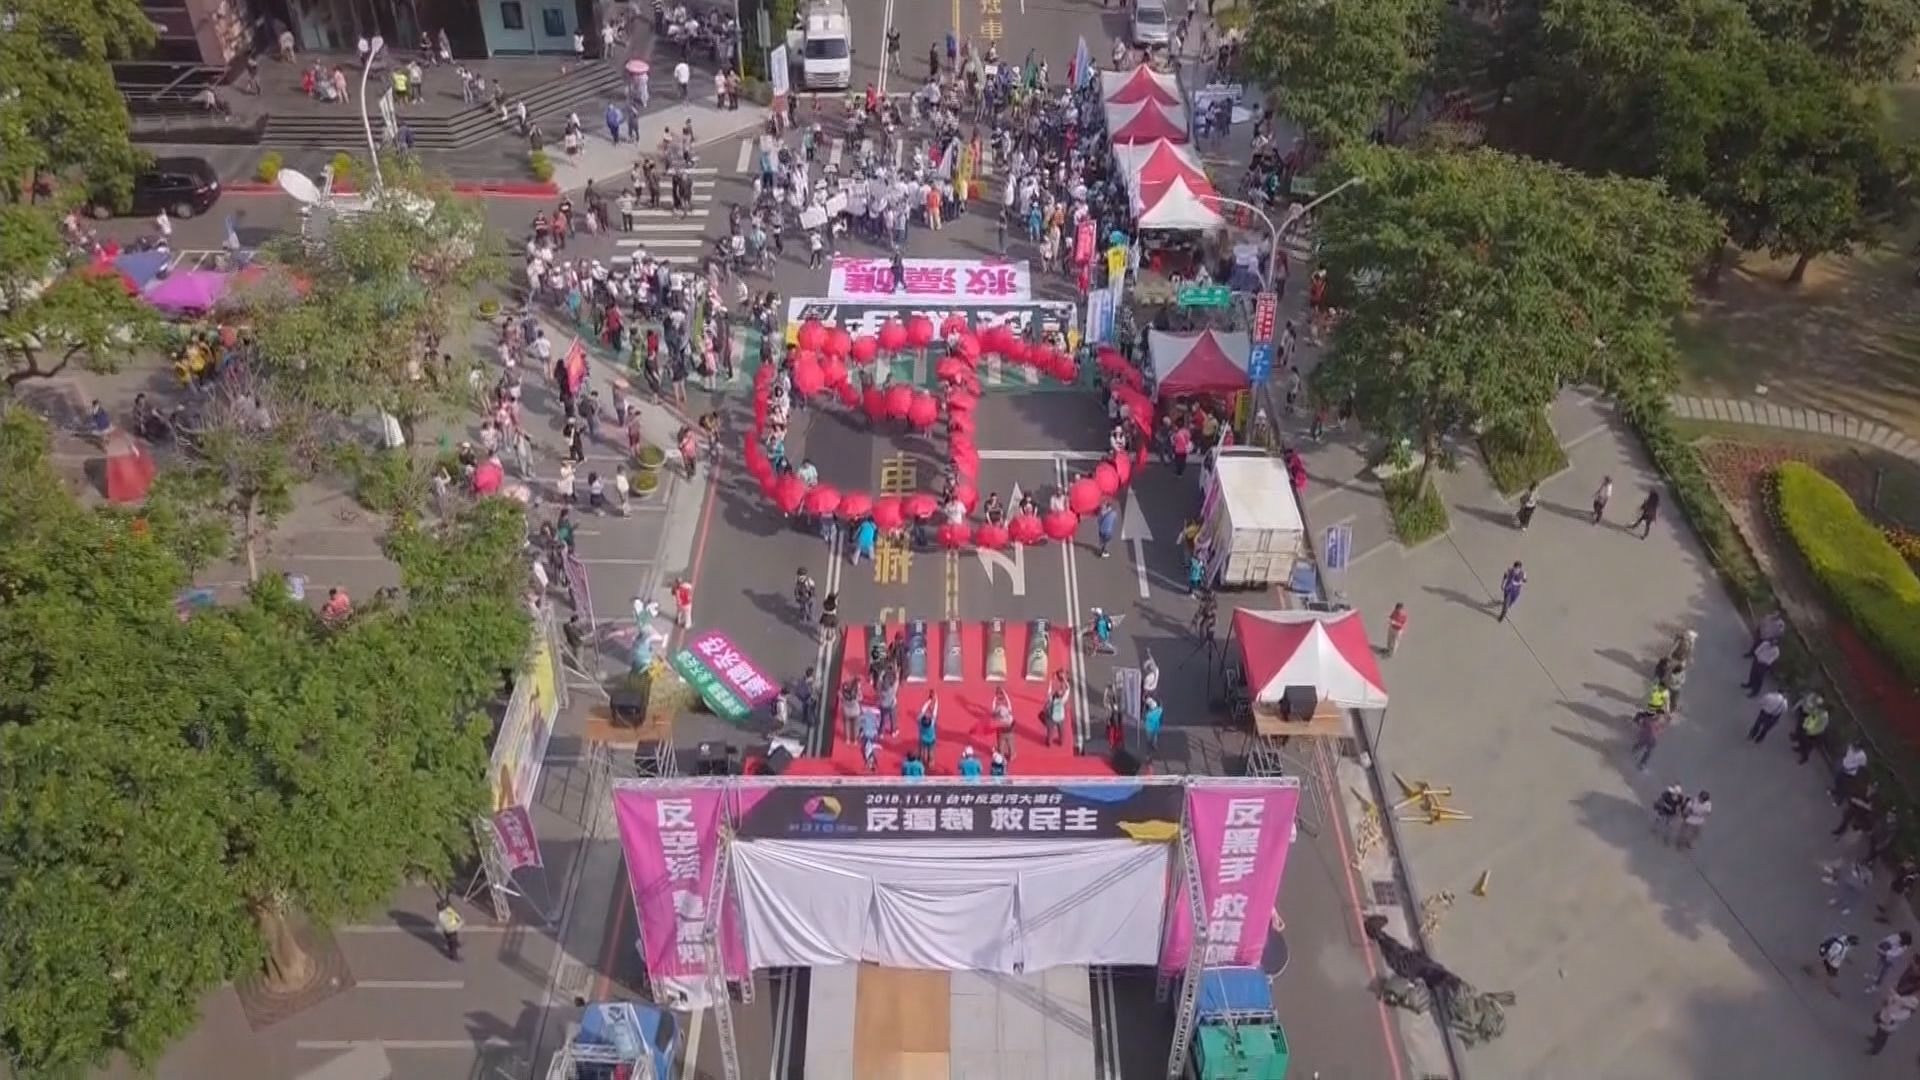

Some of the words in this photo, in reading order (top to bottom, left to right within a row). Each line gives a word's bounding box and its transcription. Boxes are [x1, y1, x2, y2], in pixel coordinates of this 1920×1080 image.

[867, 807, 974, 832] 反獨裁
[991, 806, 1098, 832] 救民主
[1219, 799, 1265, 884] 反黑手
